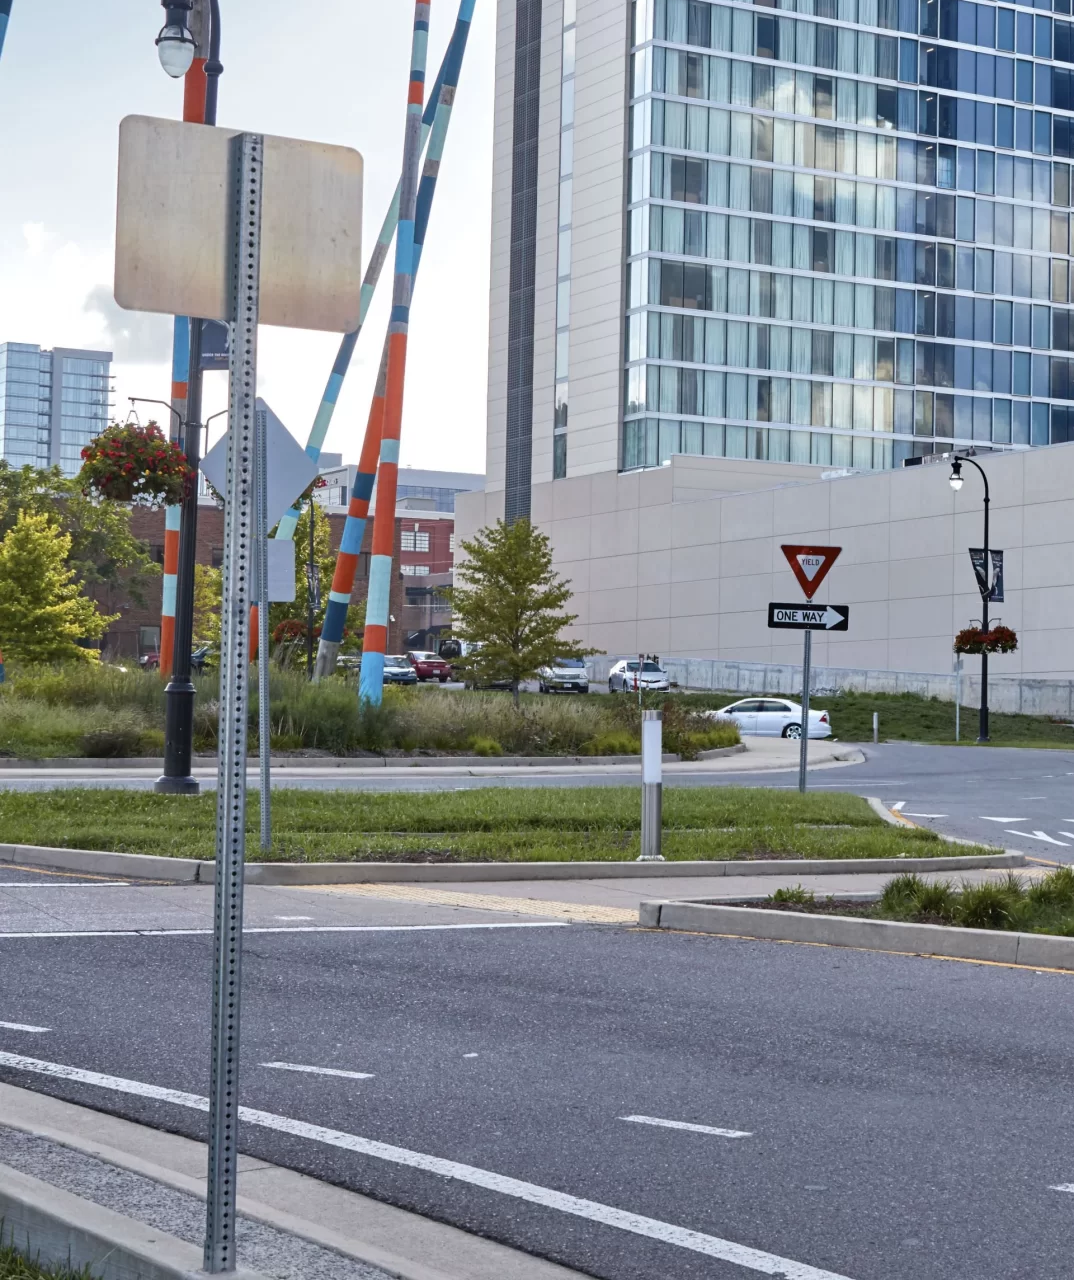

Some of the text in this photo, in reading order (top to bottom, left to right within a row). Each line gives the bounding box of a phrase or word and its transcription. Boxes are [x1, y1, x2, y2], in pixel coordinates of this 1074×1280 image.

[801, 558, 820, 566] YIELD
[776, 610, 825, 623] ONE WAY
